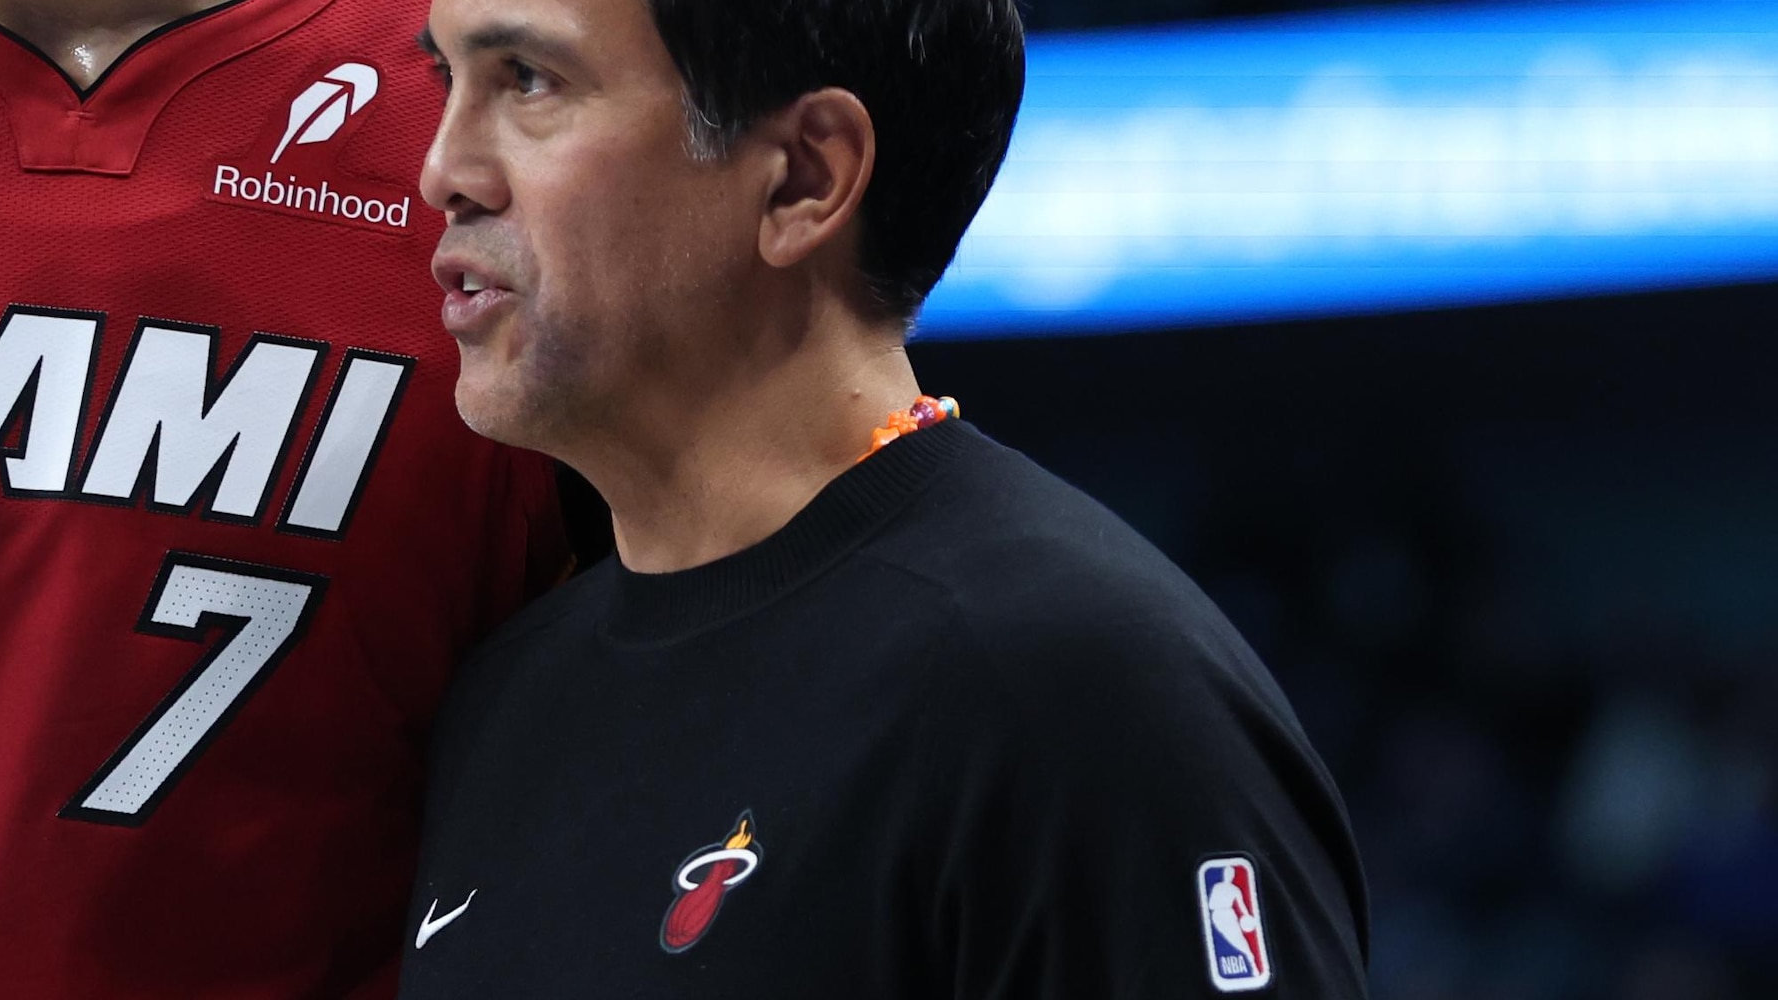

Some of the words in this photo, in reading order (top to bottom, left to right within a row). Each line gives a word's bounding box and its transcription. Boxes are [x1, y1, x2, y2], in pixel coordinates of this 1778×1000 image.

[213, 165, 411, 228] Robinhood
[57, 551, 329, 826] 7
[1220, 954, 1249, 976] NBA
